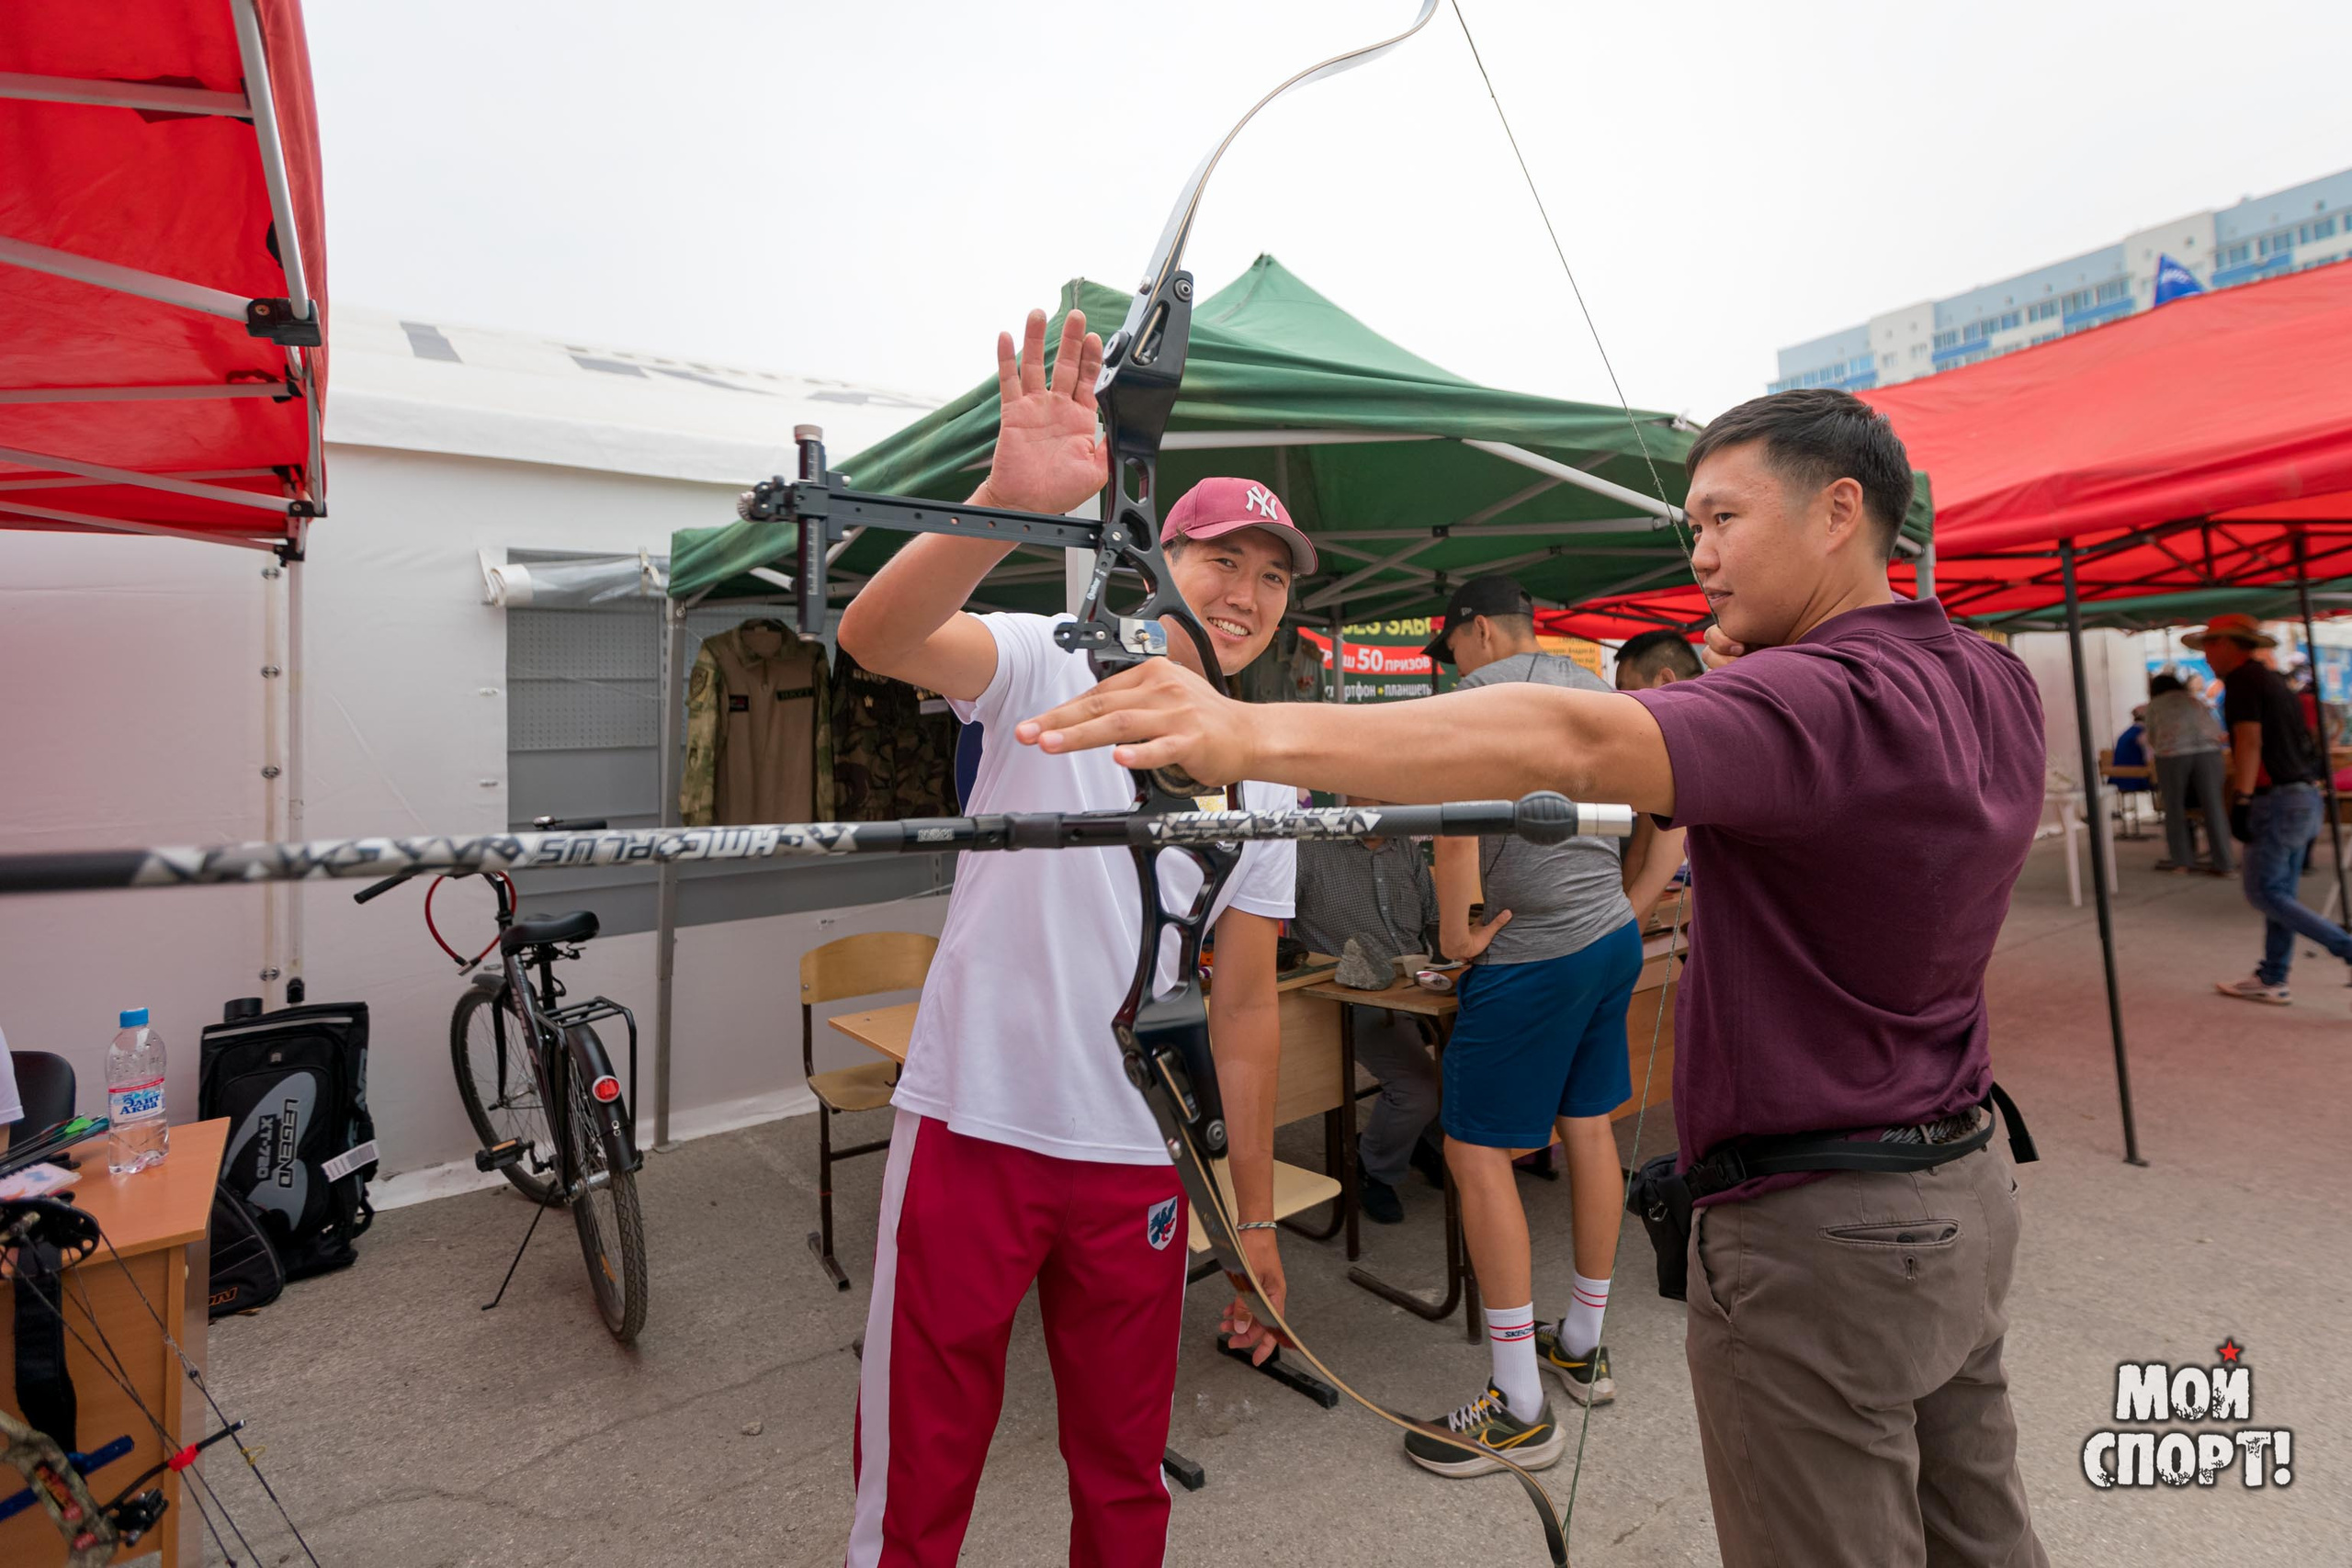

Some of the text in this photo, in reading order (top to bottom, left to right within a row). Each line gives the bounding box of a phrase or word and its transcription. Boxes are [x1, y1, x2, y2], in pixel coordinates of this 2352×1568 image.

[1245, 485, 1279, 521] NY
[1357, 648, 1384, 671] 50
[1385, 656, 1430, 671] ПРИЗОВ
[277, 1099, 299, 1189] LEGEND
